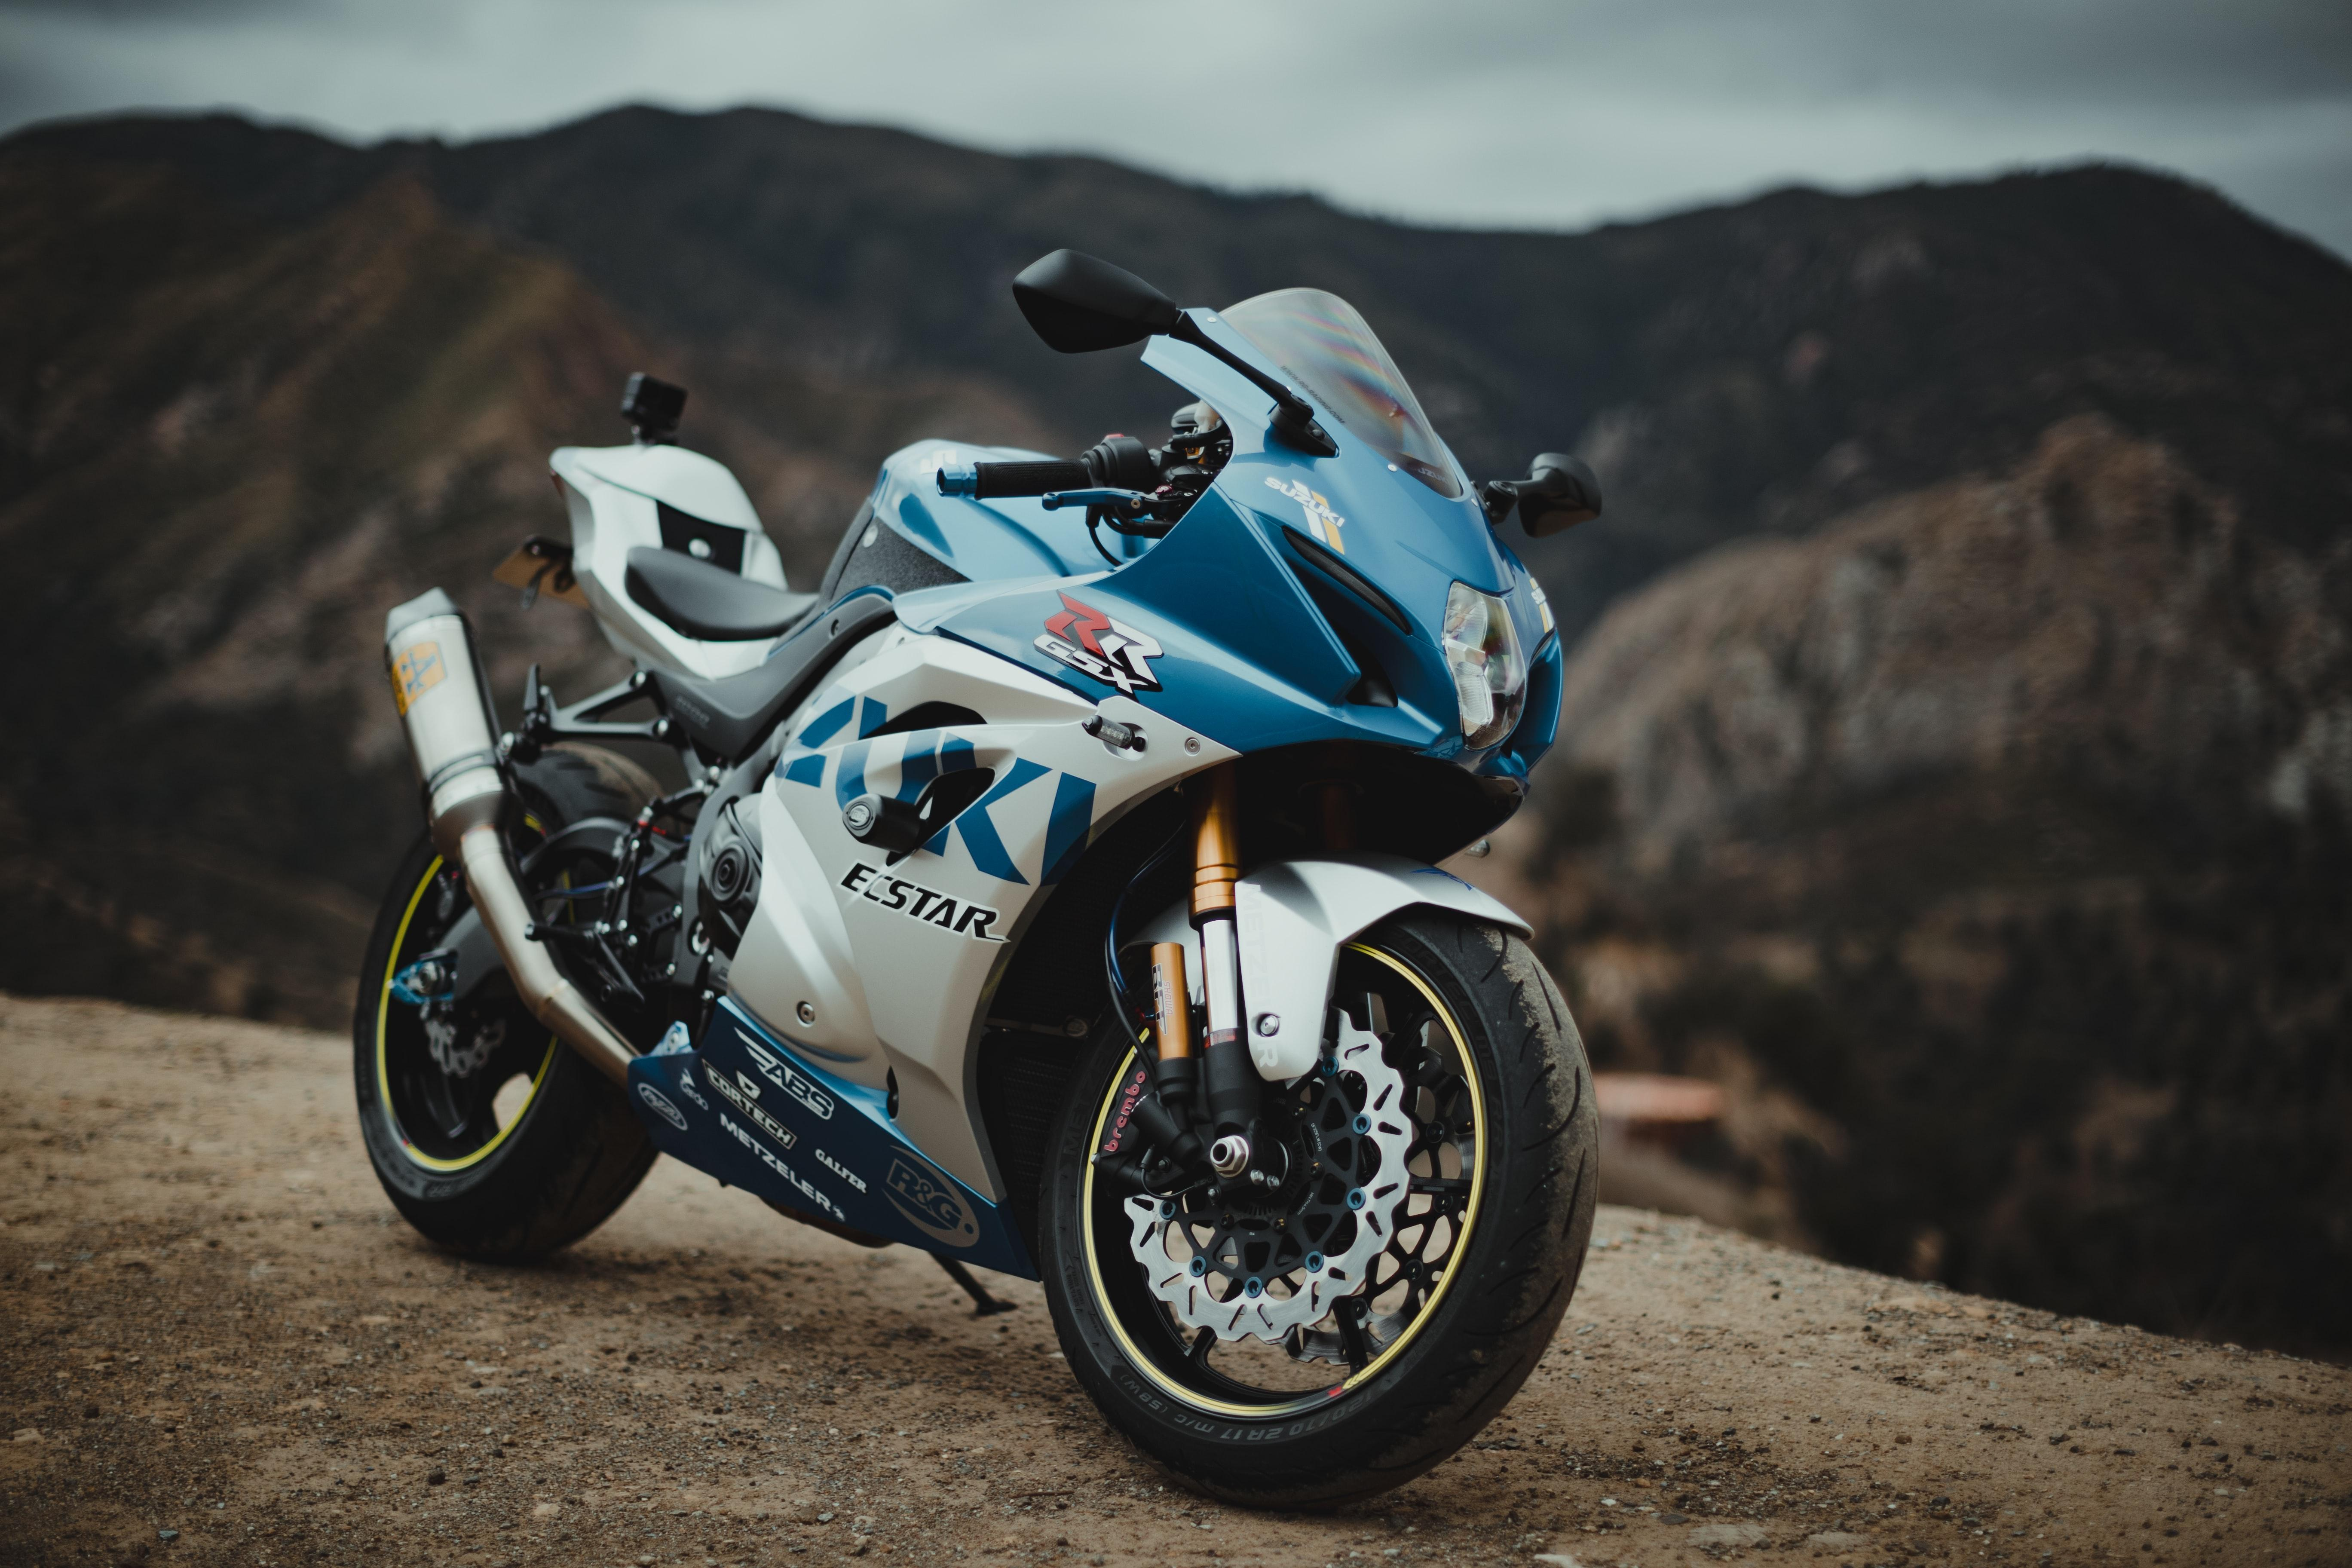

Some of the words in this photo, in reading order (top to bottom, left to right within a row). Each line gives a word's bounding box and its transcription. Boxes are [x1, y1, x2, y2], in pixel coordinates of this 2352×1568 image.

[1264, 477, 1345, 527] SUZUKI
[841, 862, 1005, 941] ECSTAR
[1164, 981, 1173, 1015] SHOWA
[707, 1066, 792, 1144] CORTECH
[765, 1063, 833, 1118] ABS
[1103, 1071, 1146, 1152] brembo
[720, 1112, 832, 1212] METZELER
[815, 1148, 867, 1193] GALFER
[887, 1160, 962, 1230] R&G
